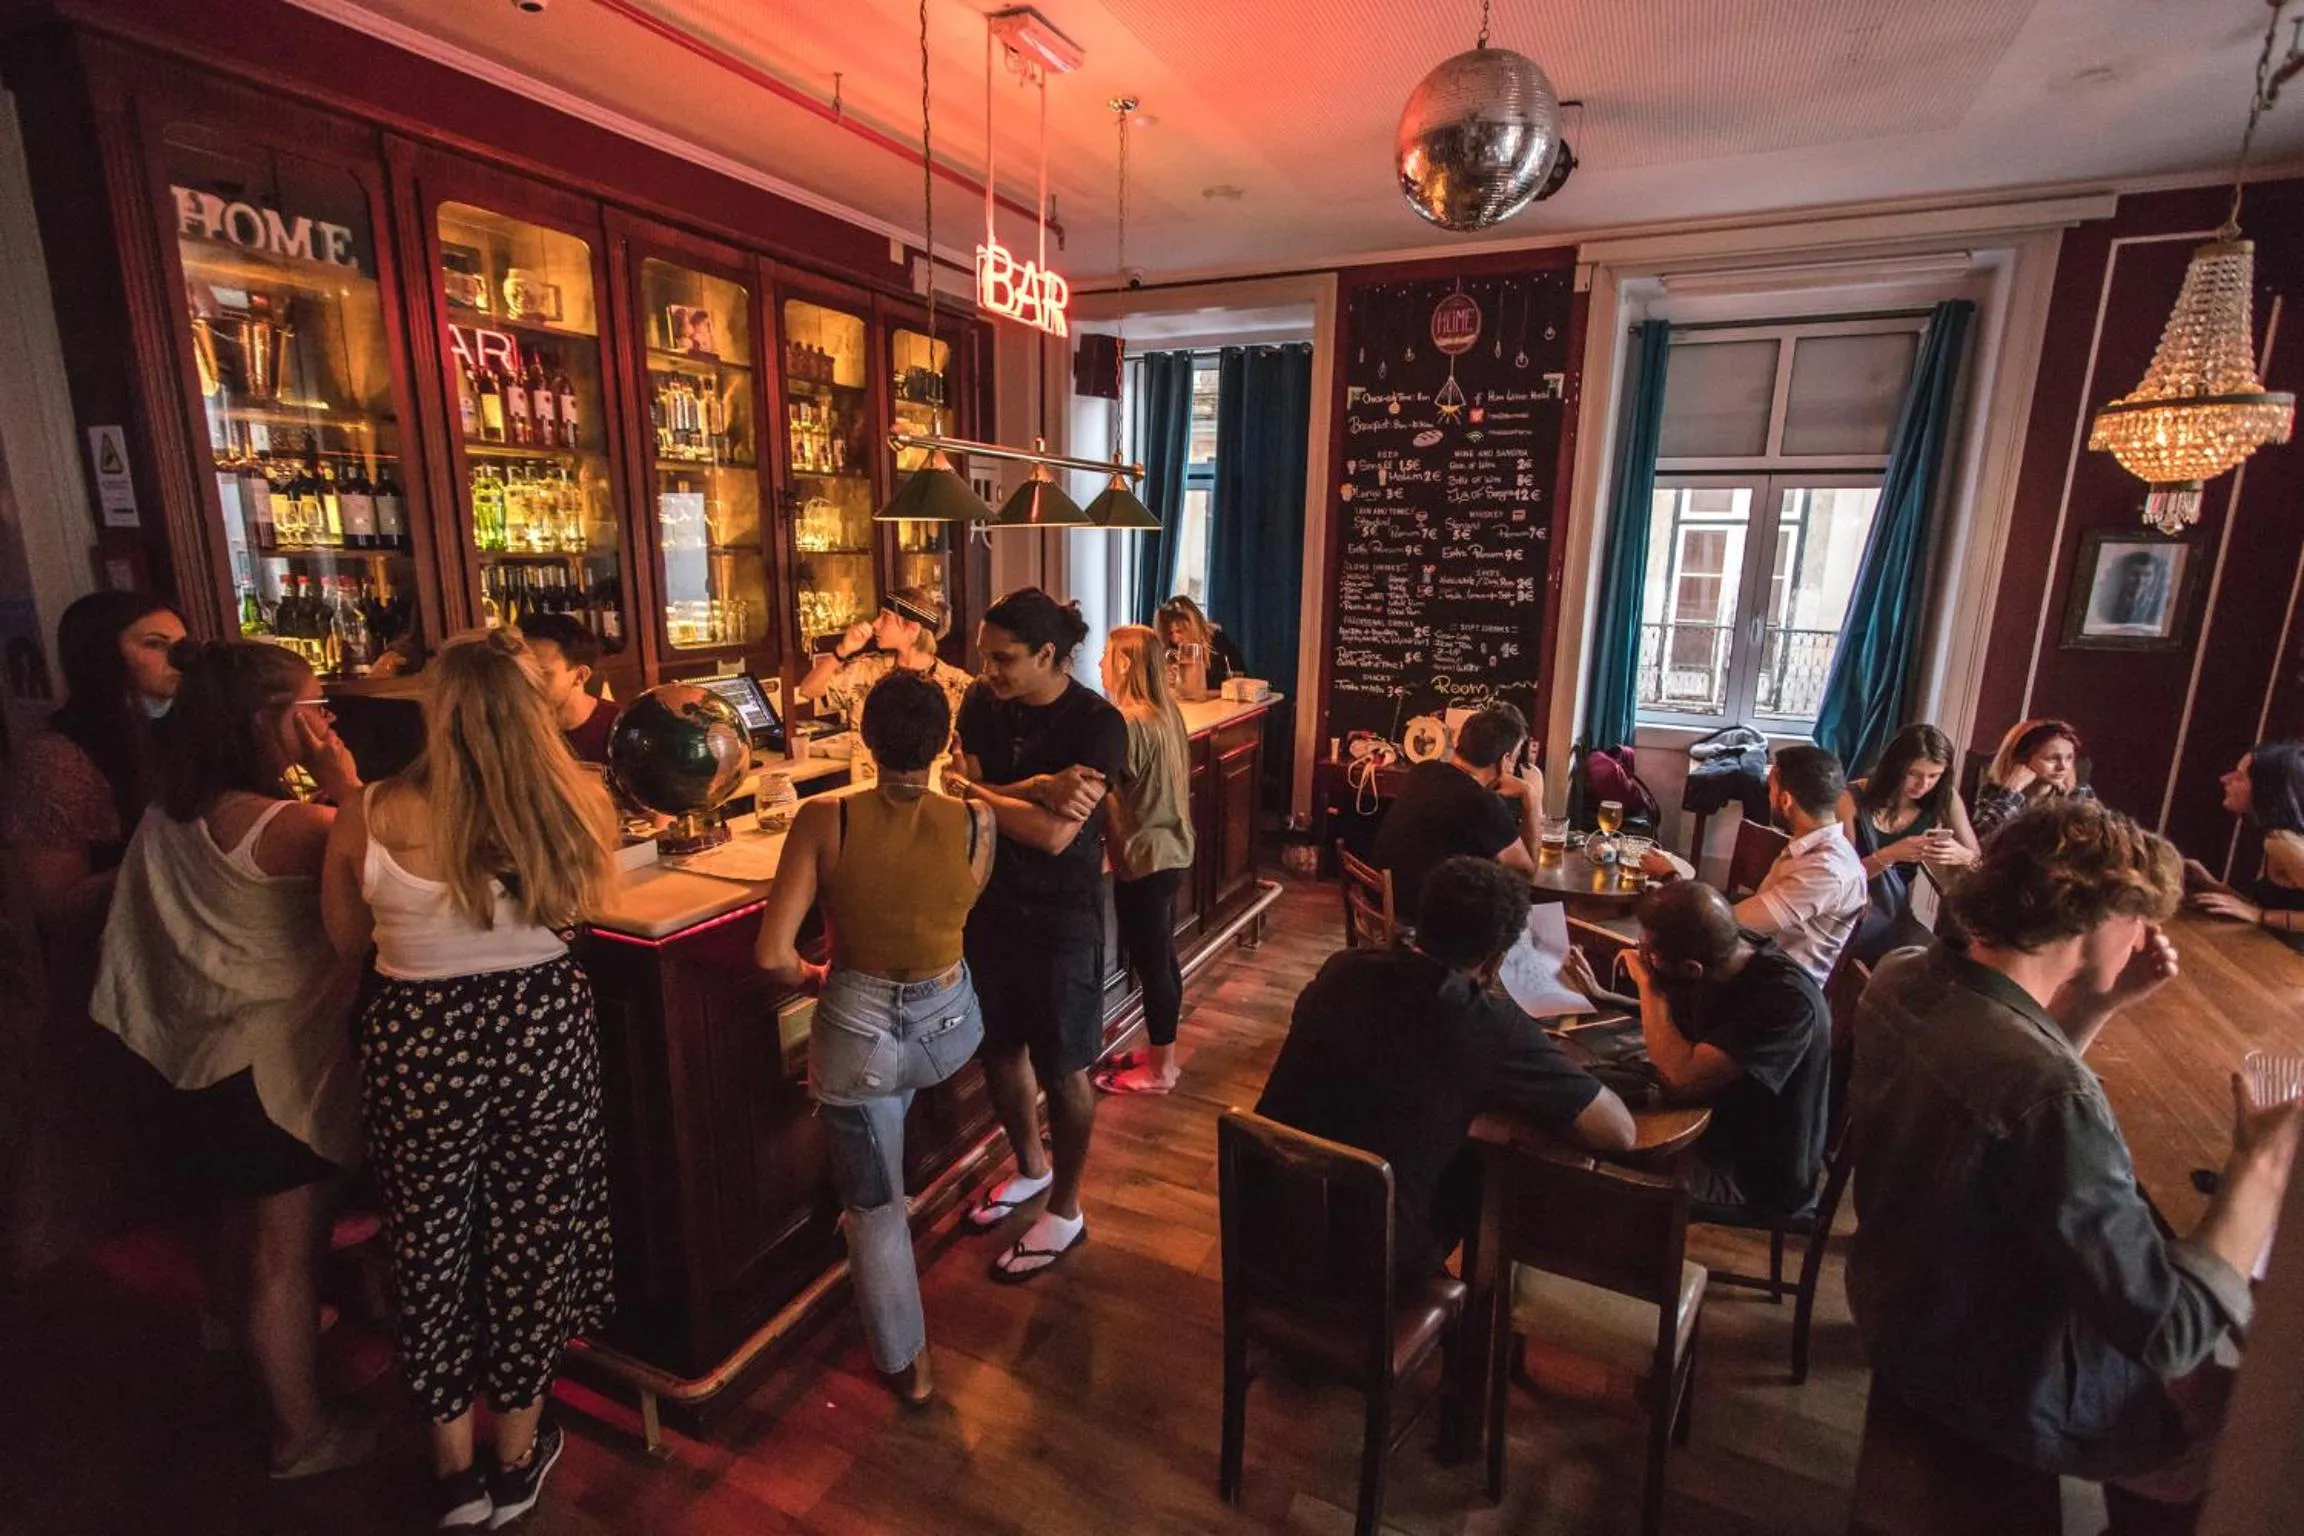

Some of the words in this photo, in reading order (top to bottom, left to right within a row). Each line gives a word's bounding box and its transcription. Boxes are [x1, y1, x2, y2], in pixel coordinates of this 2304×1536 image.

[170, 184, 359, 269] HOME
[979, 245, 1068, 338] BAR
[1477, 450, 1494, 458] AND
[1359, 459, 1392, 471] Small
[1423, 470, 1442, 483] 2€
[1515, 487, 1542, 502] 12€
[1420, 527, 1438, 540] 7€
[1404, 544, 1424, 557] 9€
[1504, 548, 1524, 561] 9€
[1430, 675, 1490, 696] Room
